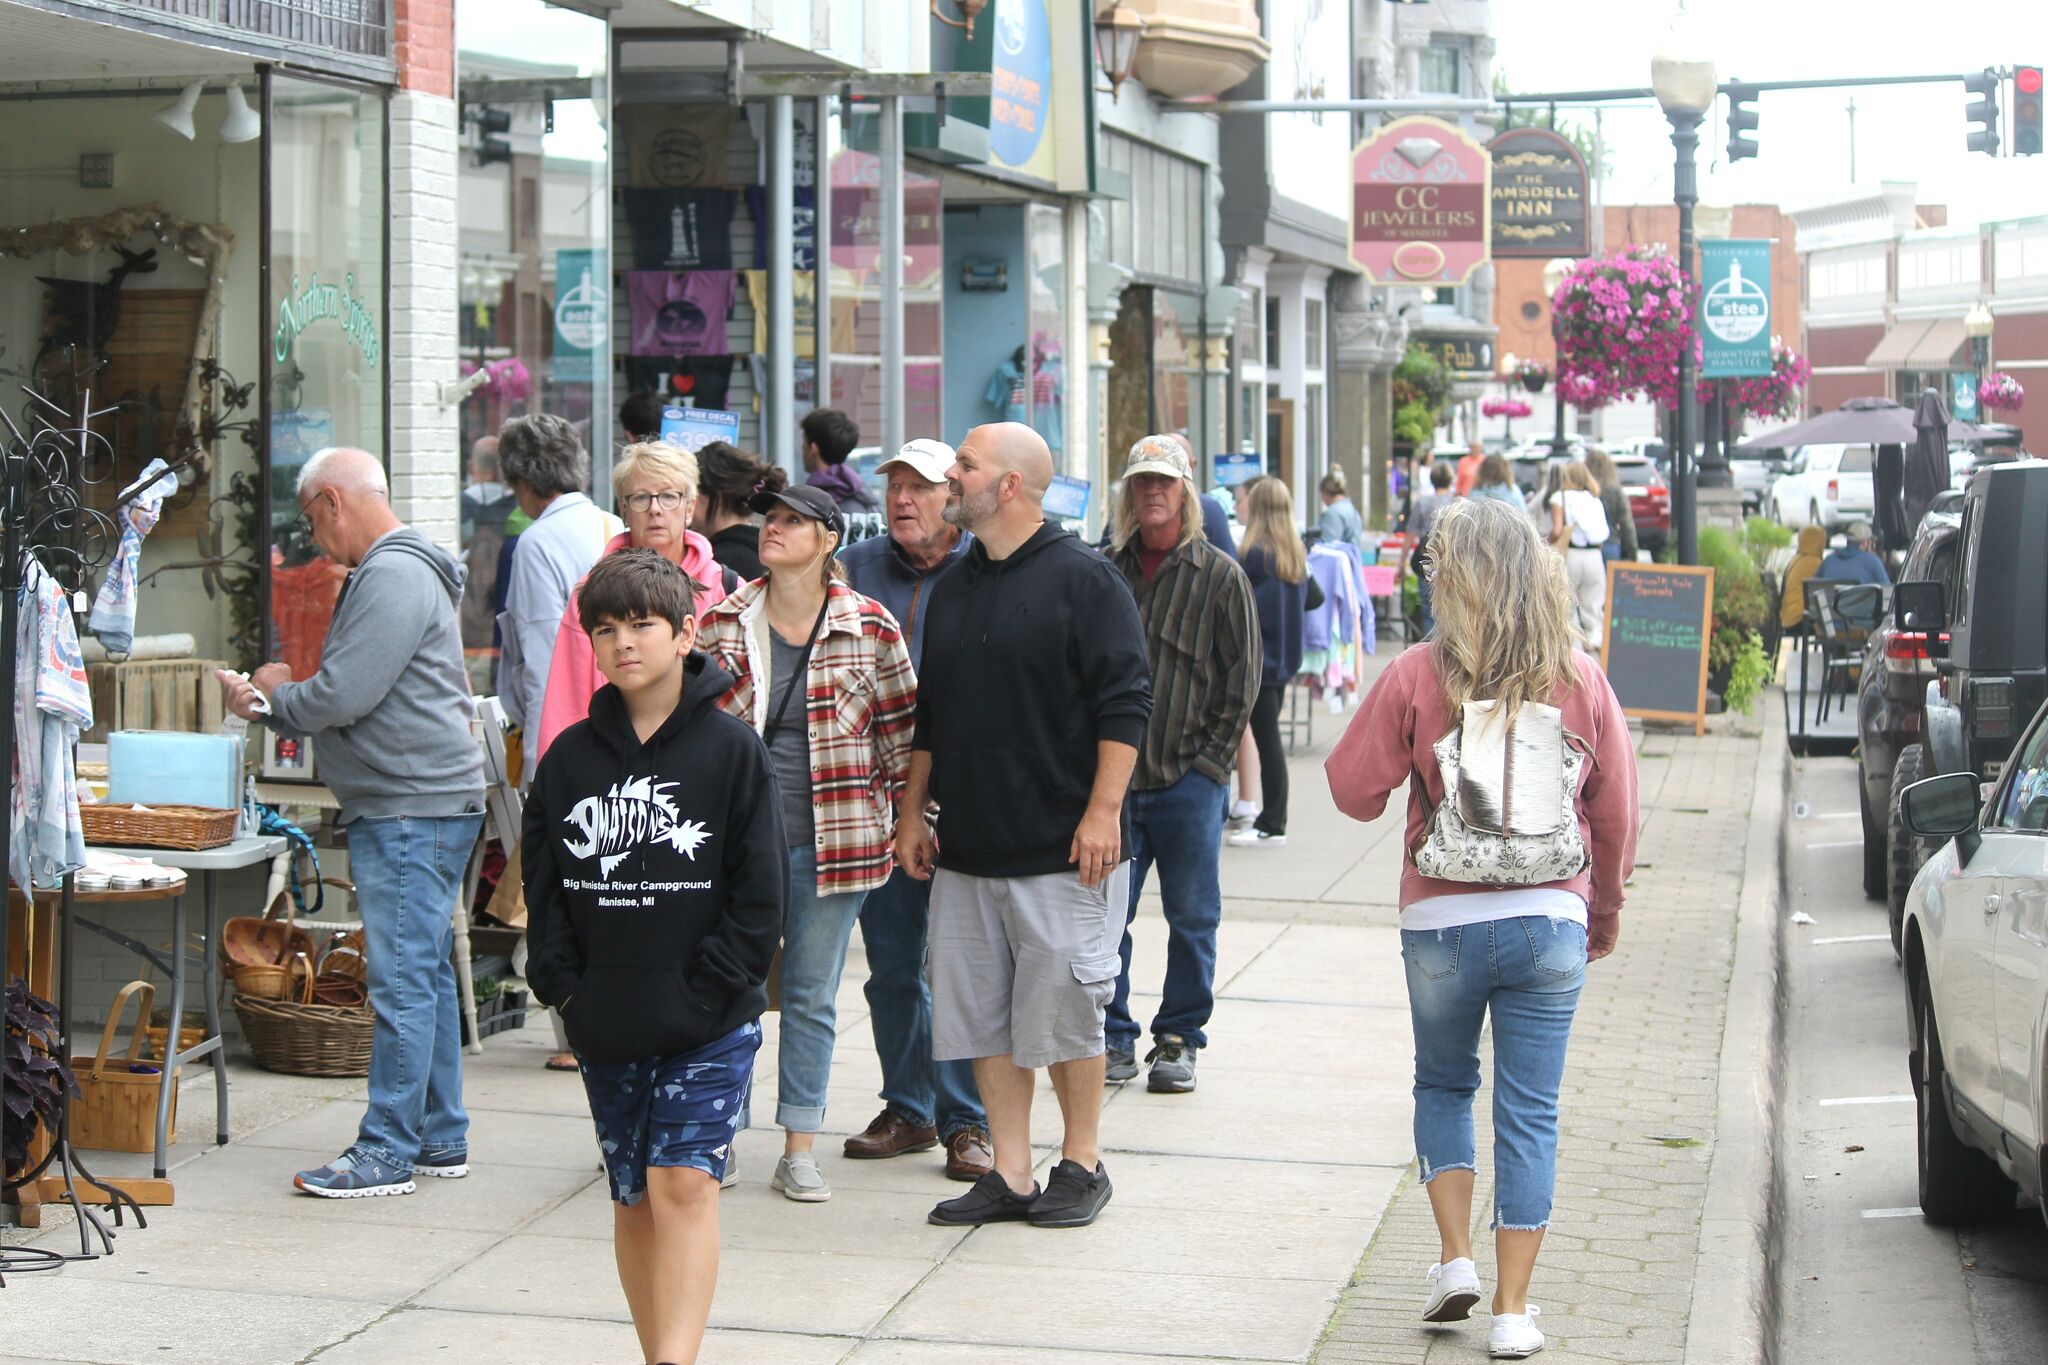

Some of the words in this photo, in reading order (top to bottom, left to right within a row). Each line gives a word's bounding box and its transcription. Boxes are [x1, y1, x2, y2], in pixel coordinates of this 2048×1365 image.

[1515, 174, 1543, 184] THE
[1396, 186, 1439, 210] CC
[1493, 186, 1579, 199] AMSDELL
[1507, 200, 1552, 216] INN
[1363, 210, 1477, 227] JEWELERS
[1703, 249, 1749, 257] WELCOME
[1722, 301, 1760, 315] stee
[275, 272, 338, 364] Northern
[1444, 341, 1475, 368] Pub
[1705, 350, 1768, 360] DOWNTOWN
[1711, 359, 1761, 369] MANISTEE
[684, 410, 707, 420] FREE
[708, 412, 736, 423] DECAL
[563, 878, 580, 891] Big
[581, 879, 610, 891] Manistee
[611, 881, 638, 891] River
[640, 880, 712, 892] Campground
[598, 896, 640, 908] Manistee,
[642, 896, 655, 906] MI
